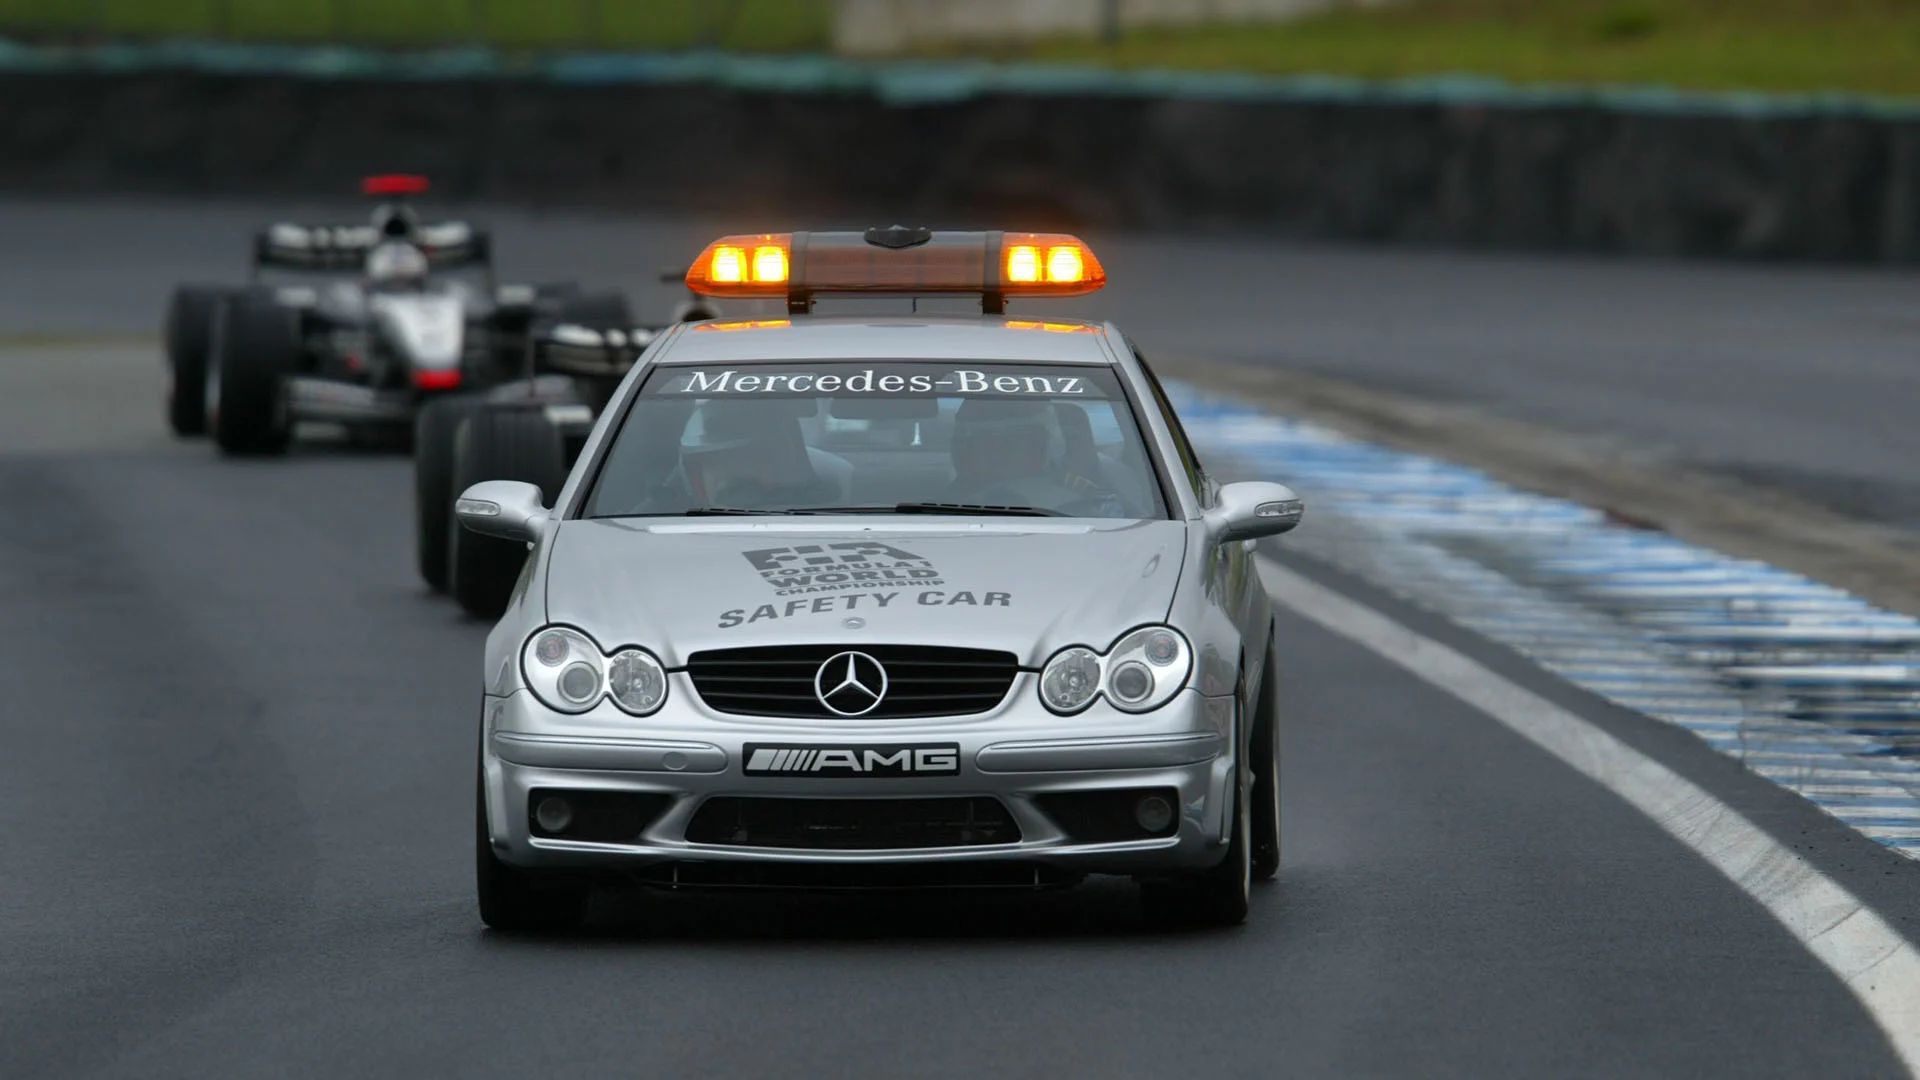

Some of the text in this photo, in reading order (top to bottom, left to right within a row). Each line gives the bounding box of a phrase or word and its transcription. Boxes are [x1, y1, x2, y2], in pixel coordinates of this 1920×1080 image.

[680, 370, 1084, 394] Mercedes-Benz
[742, 542, 926, 571] FIA
[760, 562, 913, 578] FORMULA
[767, 570, 939, 588] WORLD
[776, 580, 945, 596] CHAMPIONSHIP
[717, 591, 1012, 628] SAFETY CAR
[809, 748, 957, 772] AMG
